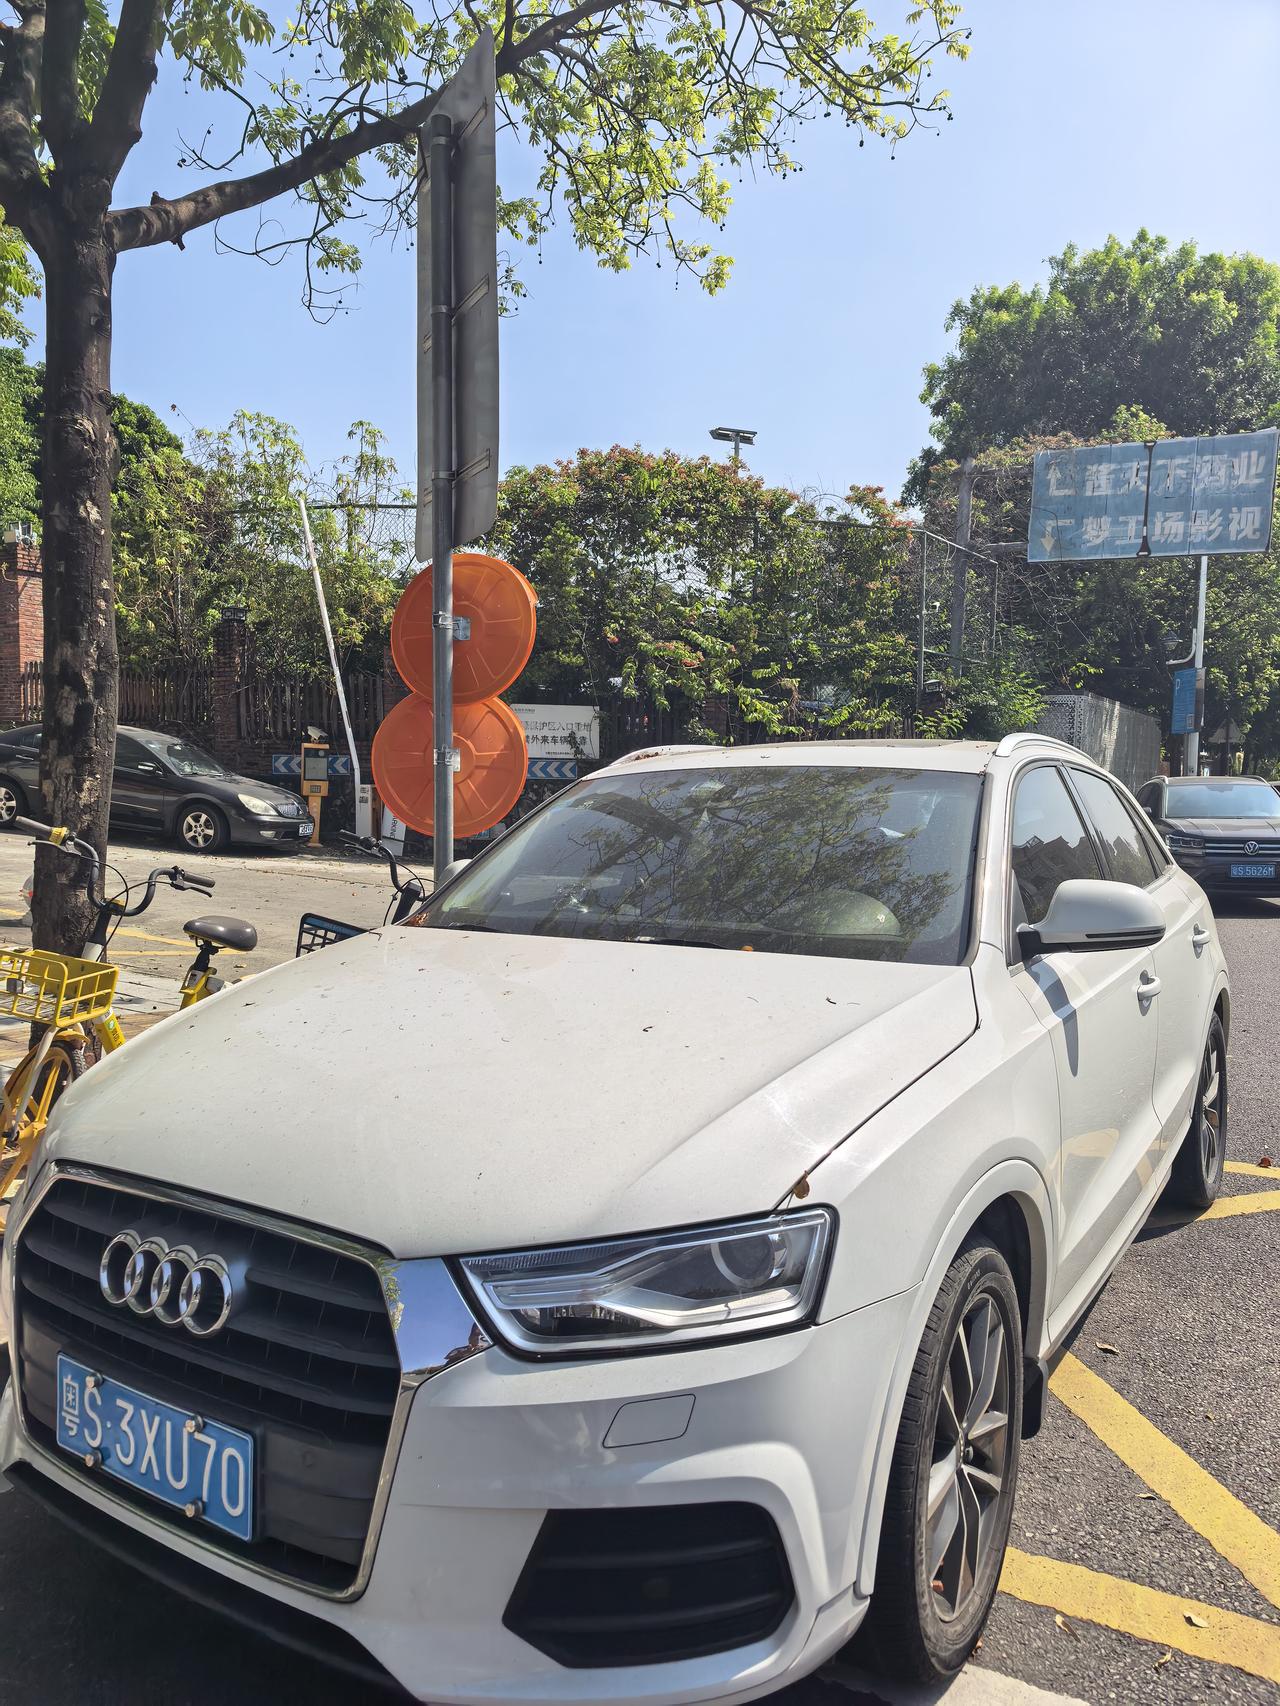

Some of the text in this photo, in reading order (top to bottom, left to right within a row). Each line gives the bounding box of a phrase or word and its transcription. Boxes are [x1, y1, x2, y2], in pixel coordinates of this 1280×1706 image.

[1081, 506, 1262, 547] 梦工场影视
